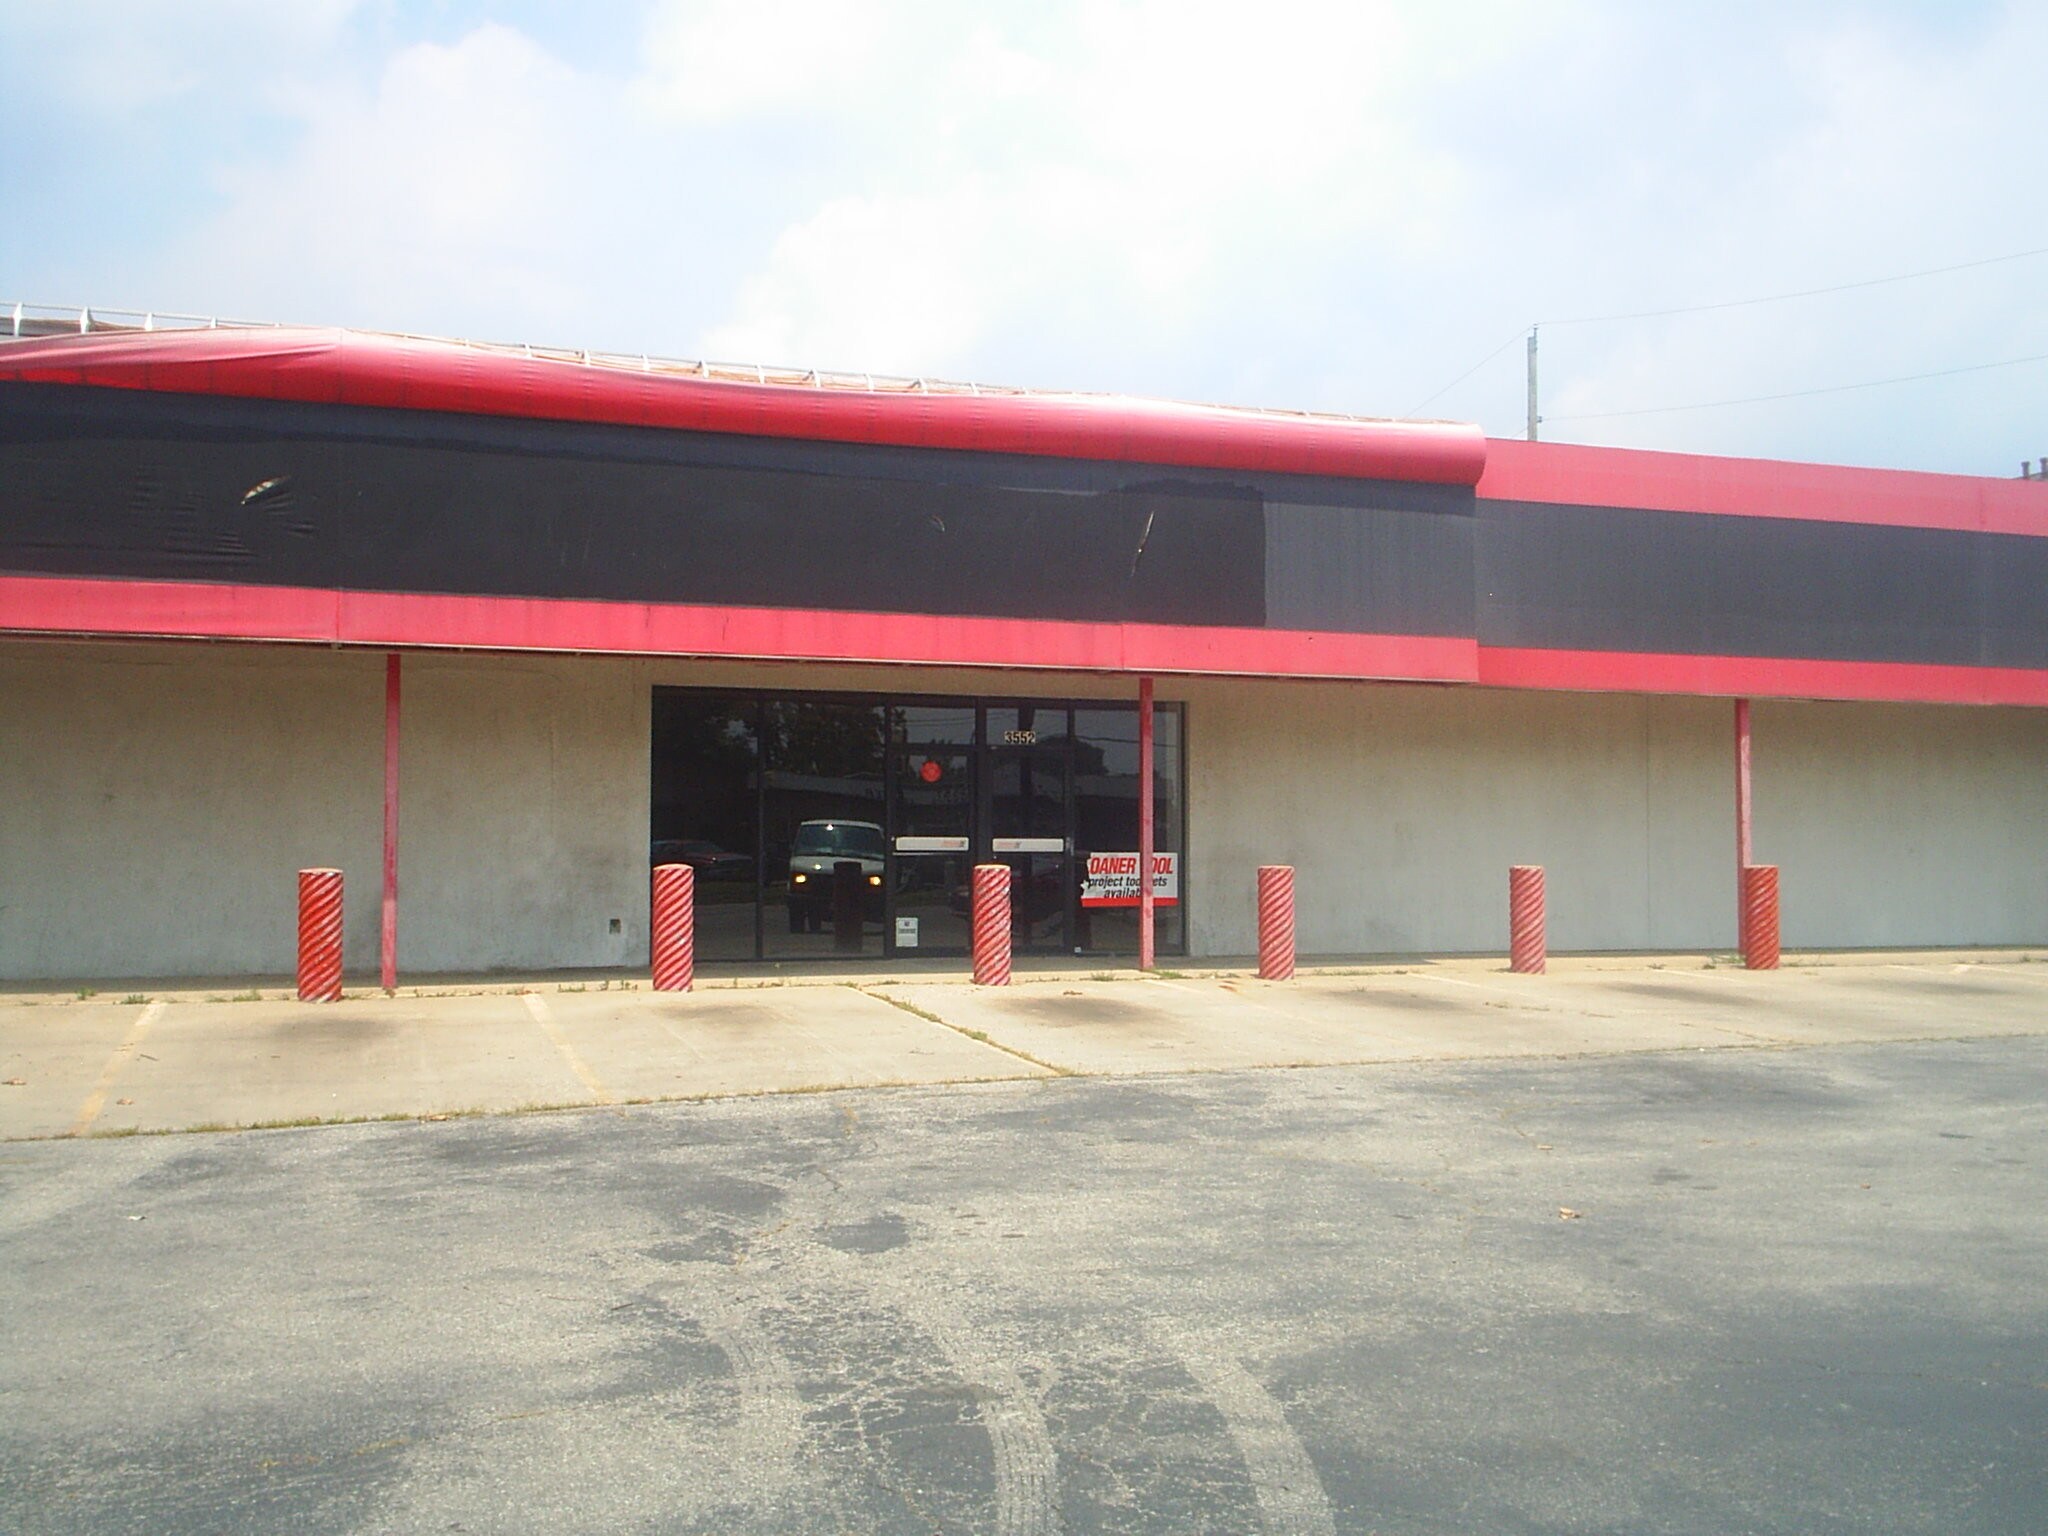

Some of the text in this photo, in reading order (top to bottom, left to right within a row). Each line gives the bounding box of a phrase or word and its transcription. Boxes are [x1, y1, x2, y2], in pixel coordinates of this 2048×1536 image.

[1005, 730, 1036, 744] 3552
[1089, 857, 1137, 874] OANER
[1087, 875, 1168, 890] project too ets
[1103, 887, 1141, 899] availab
